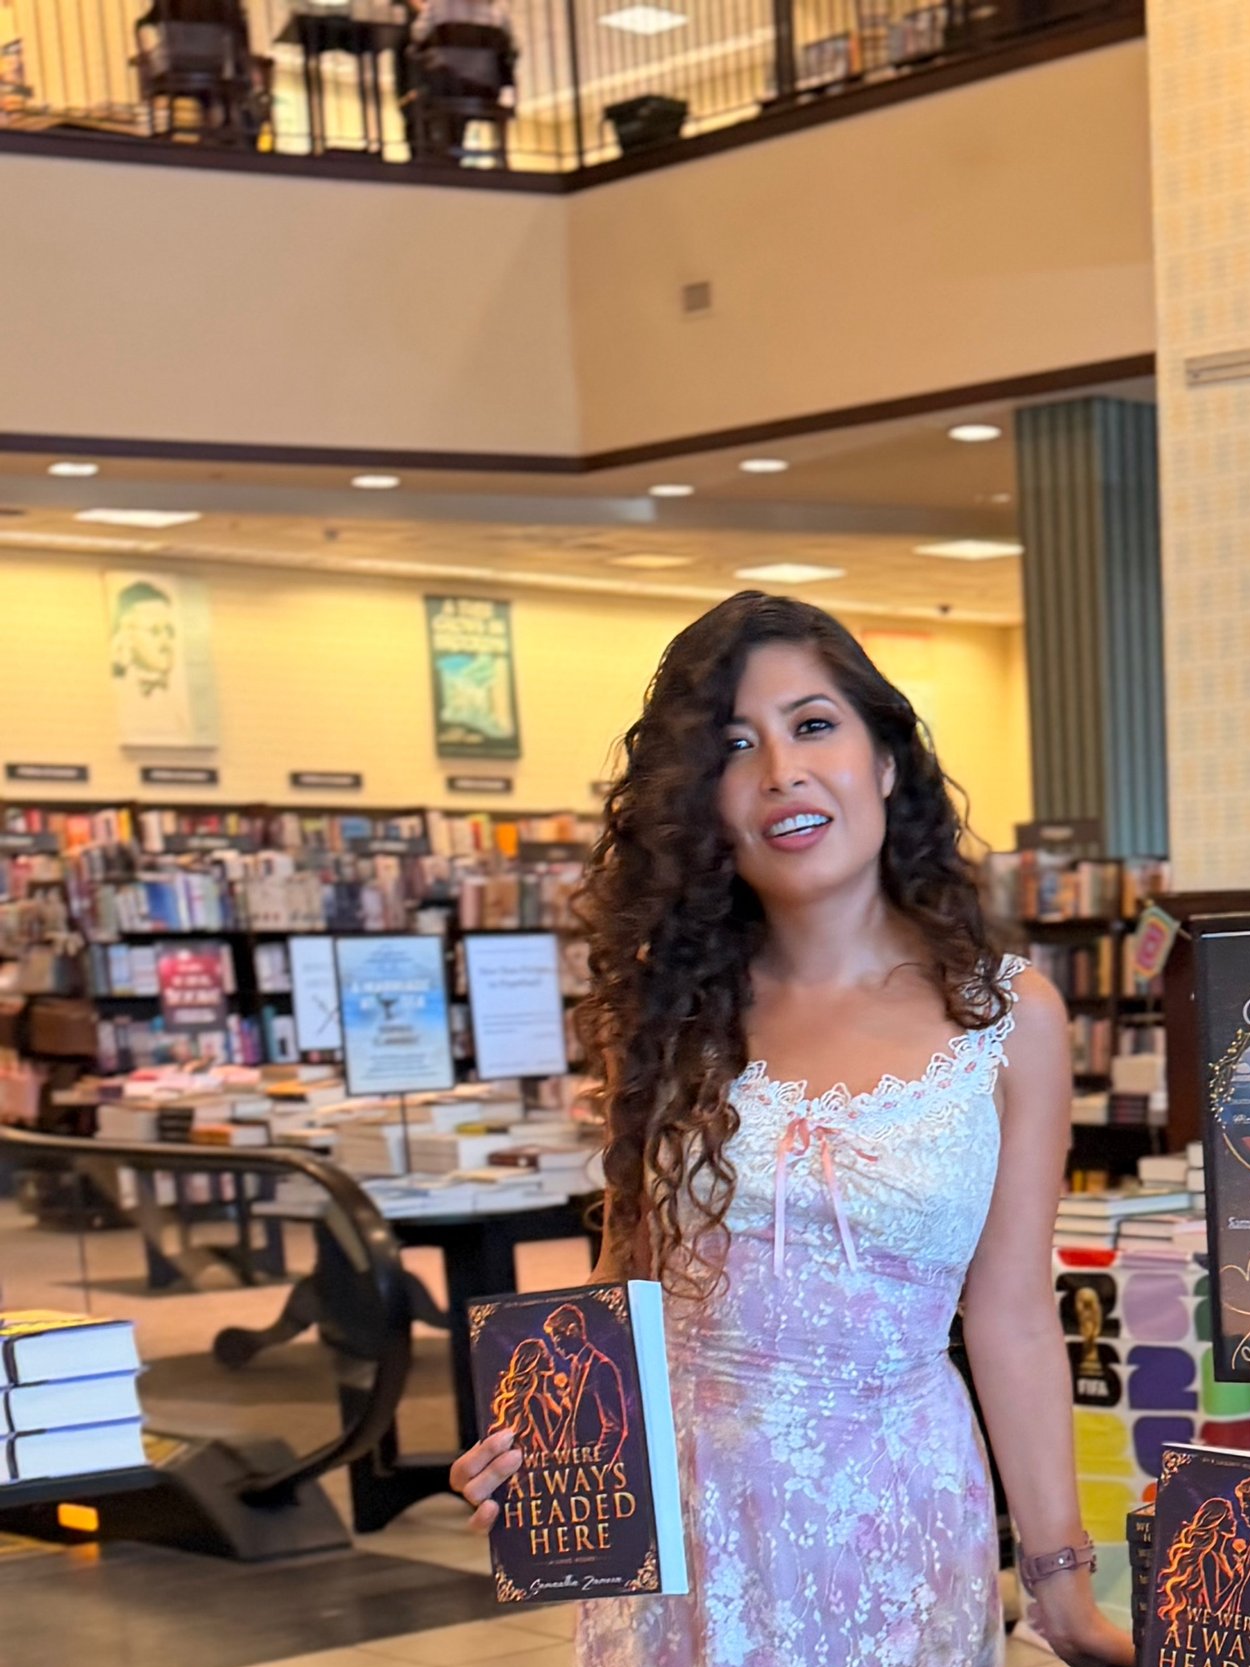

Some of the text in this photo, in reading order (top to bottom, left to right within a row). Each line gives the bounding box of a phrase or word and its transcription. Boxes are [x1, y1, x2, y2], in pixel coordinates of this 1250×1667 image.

[523, 1446, 602, 1468] WE WERE
[507, 1462, 628, 1499] ALWAYS
[504, 1491, 636, 1529] HEADED
[530, 1523, 611, 1556] HERE
[1186, 1605, 1211, 1625] WE
